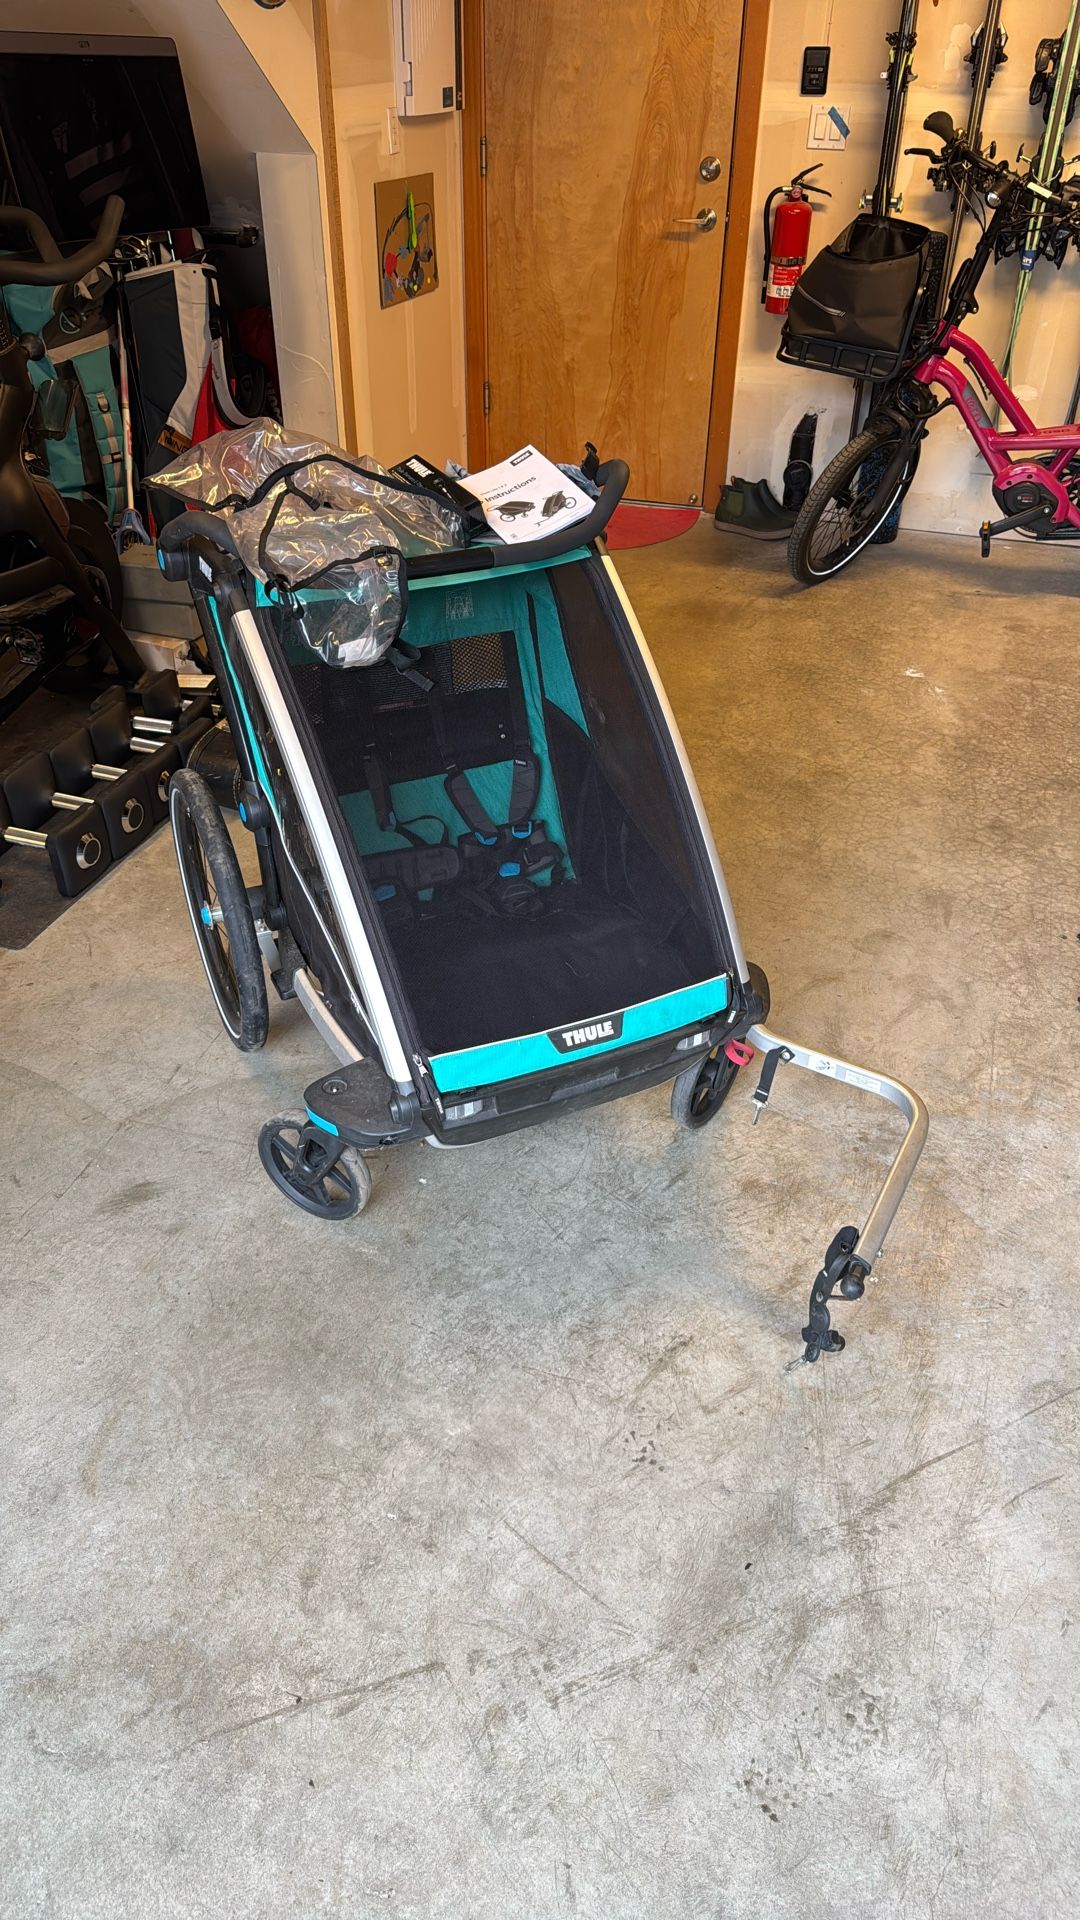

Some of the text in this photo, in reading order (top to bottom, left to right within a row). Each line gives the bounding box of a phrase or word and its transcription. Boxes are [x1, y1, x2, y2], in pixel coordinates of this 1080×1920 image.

[405, 458, 433, 478] THULE
[484, 476, 537, 502] Instructions
[561, 1020, 615, 1047] THULE
